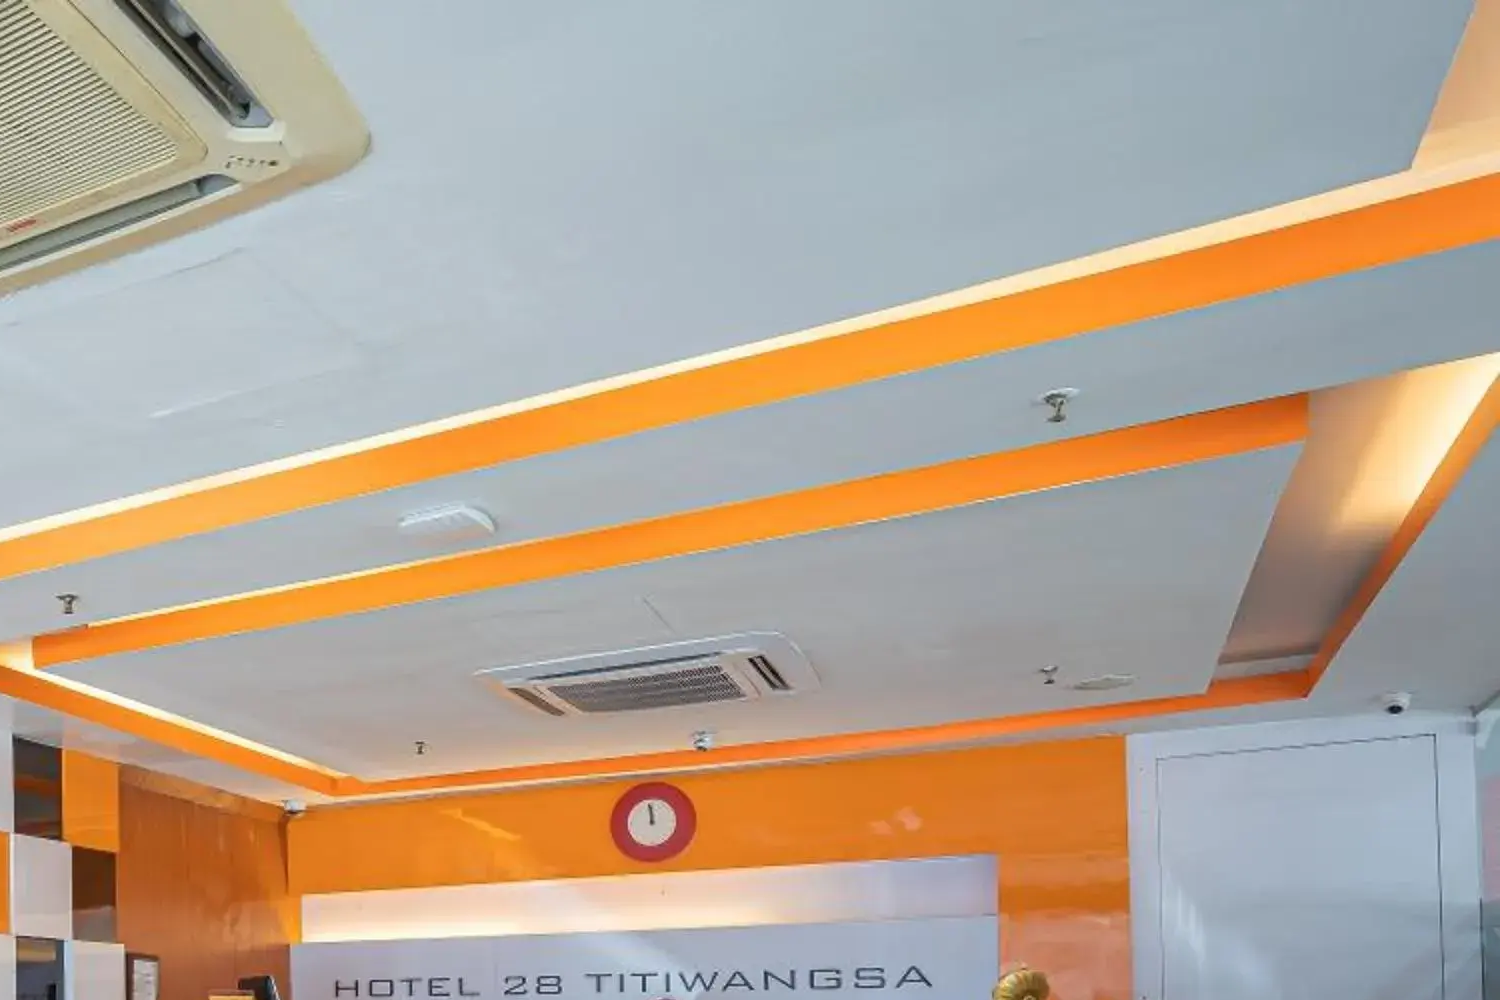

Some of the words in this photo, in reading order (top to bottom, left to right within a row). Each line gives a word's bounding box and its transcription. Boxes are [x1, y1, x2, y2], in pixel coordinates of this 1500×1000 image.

[334, 976, 481, 998] HOTEL
[503, 975, 564, 996] 28
[585, 965, 933, 993] TITIWANGSA
